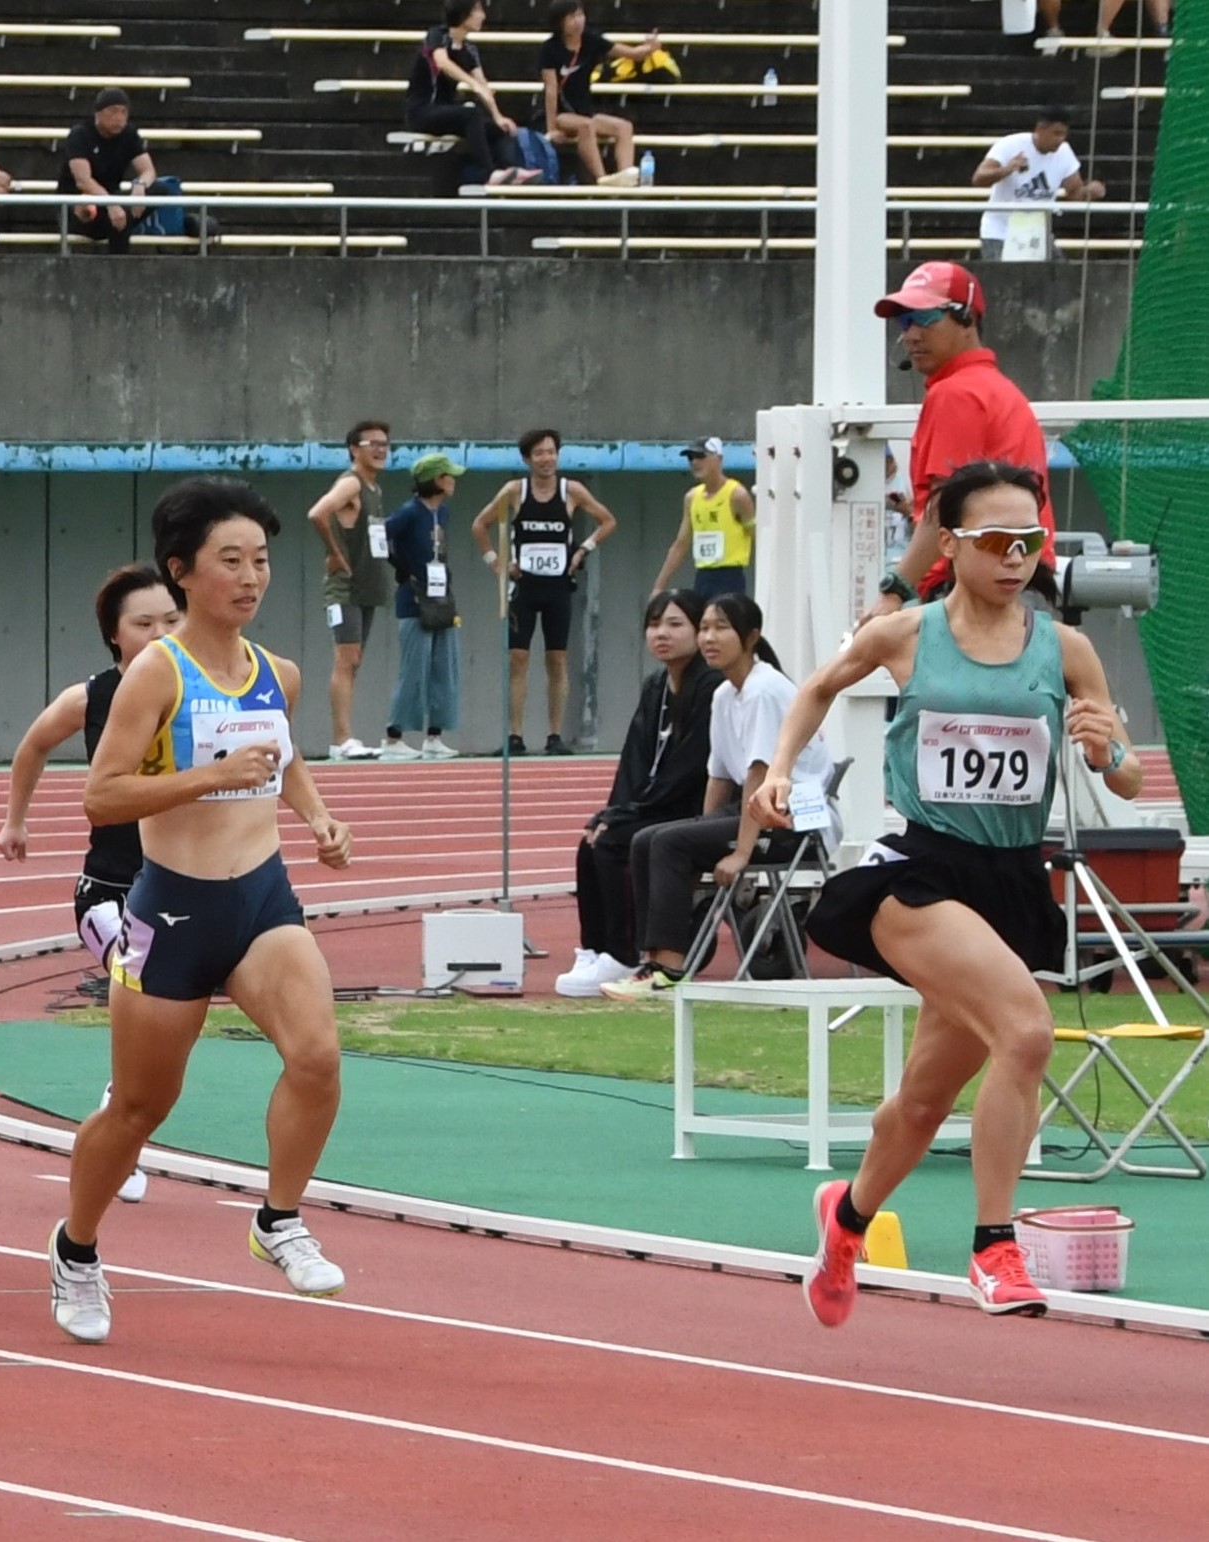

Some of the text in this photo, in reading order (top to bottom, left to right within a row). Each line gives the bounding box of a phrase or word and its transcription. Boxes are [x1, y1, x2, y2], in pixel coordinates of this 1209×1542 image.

[521, 521, 565, 532] TOKYO
[529, 556, 560, 570] 1045
[940, 747, 1029, 791] 1979
[87, 917, 103, 946] 1
